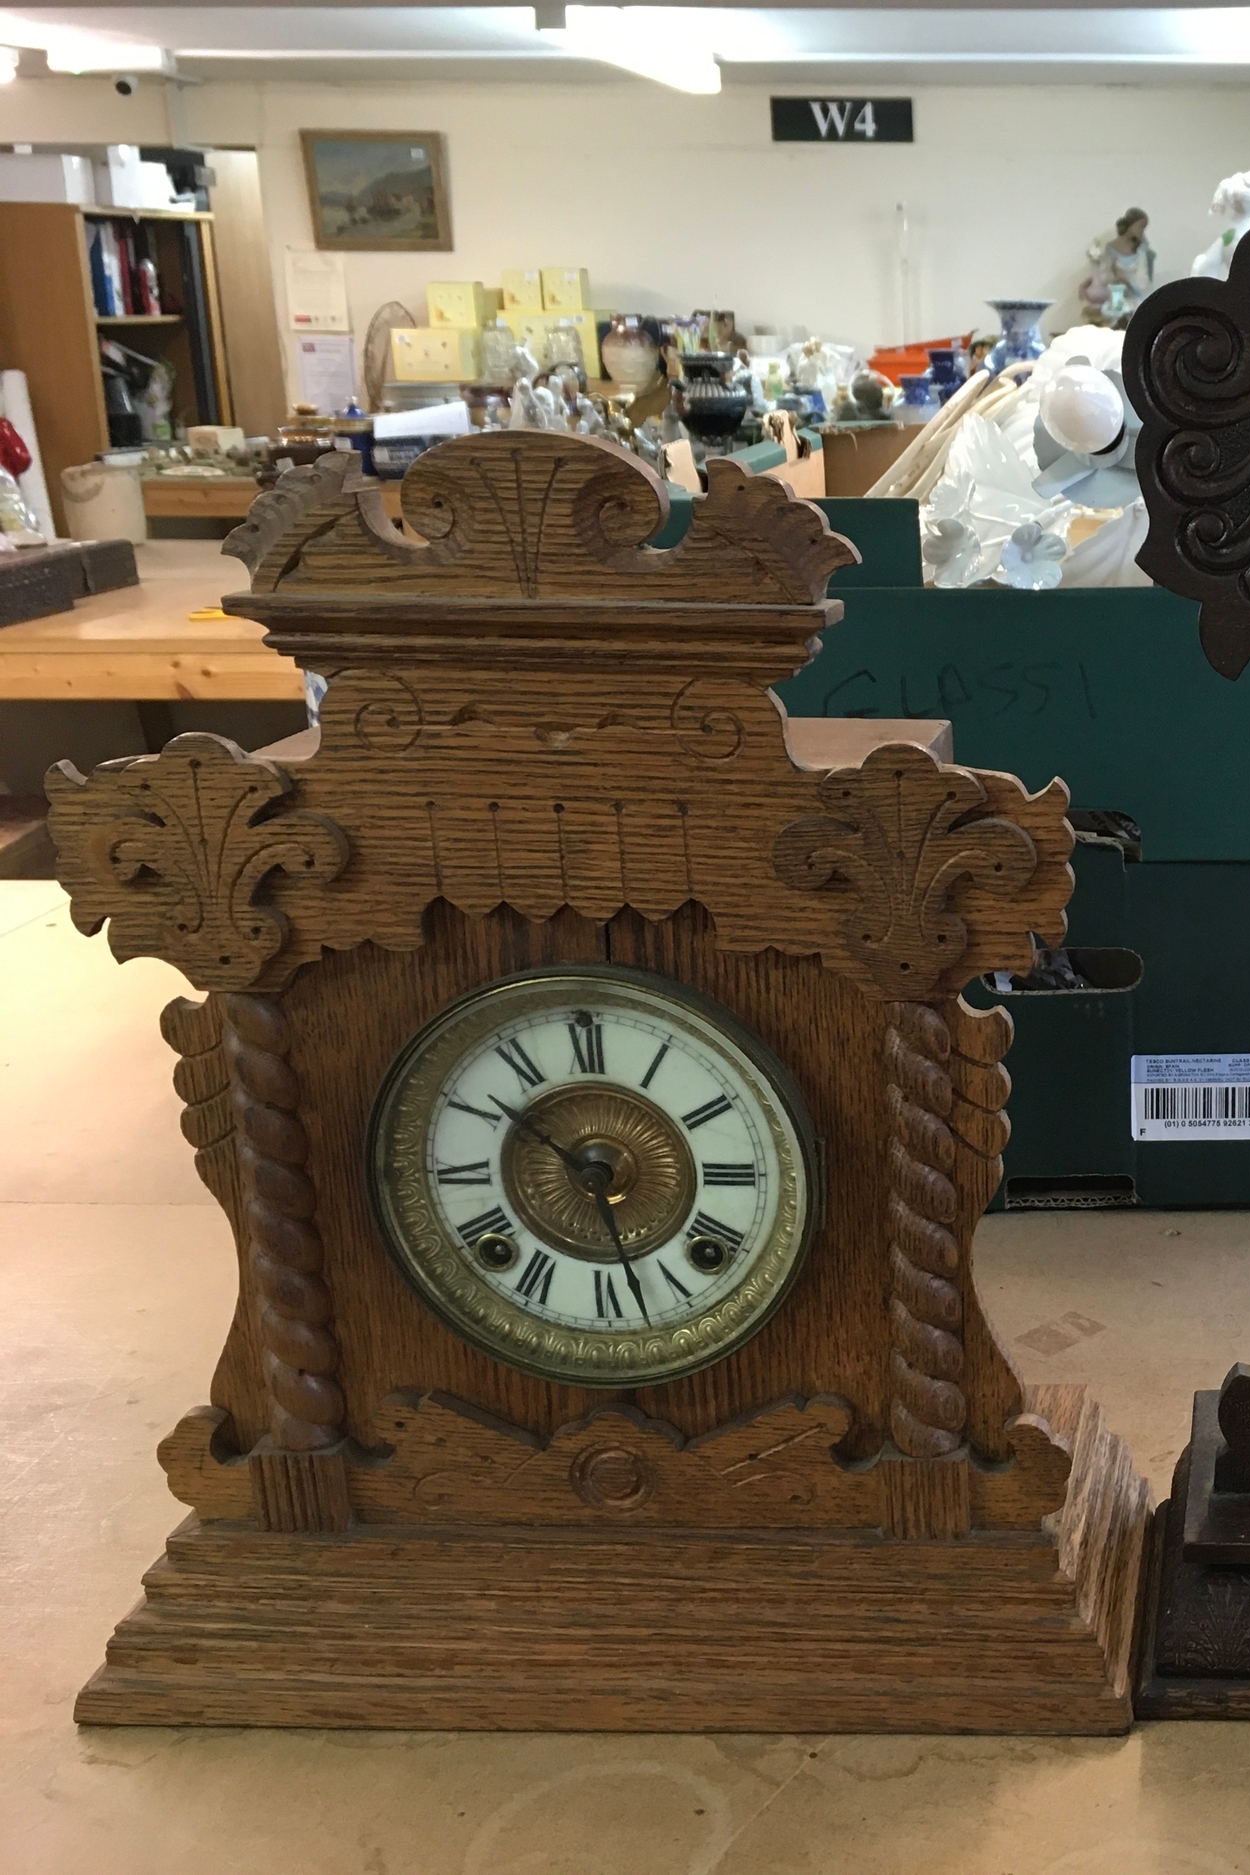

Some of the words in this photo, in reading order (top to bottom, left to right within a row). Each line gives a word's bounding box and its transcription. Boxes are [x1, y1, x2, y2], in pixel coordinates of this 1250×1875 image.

[809, 101, 877, 138] W4
[1164, 1120, 1179, 1128] (01)
[1188, 1119, 1221, 1127] 5054775
[1139, 1128, 1146, 1136] F
